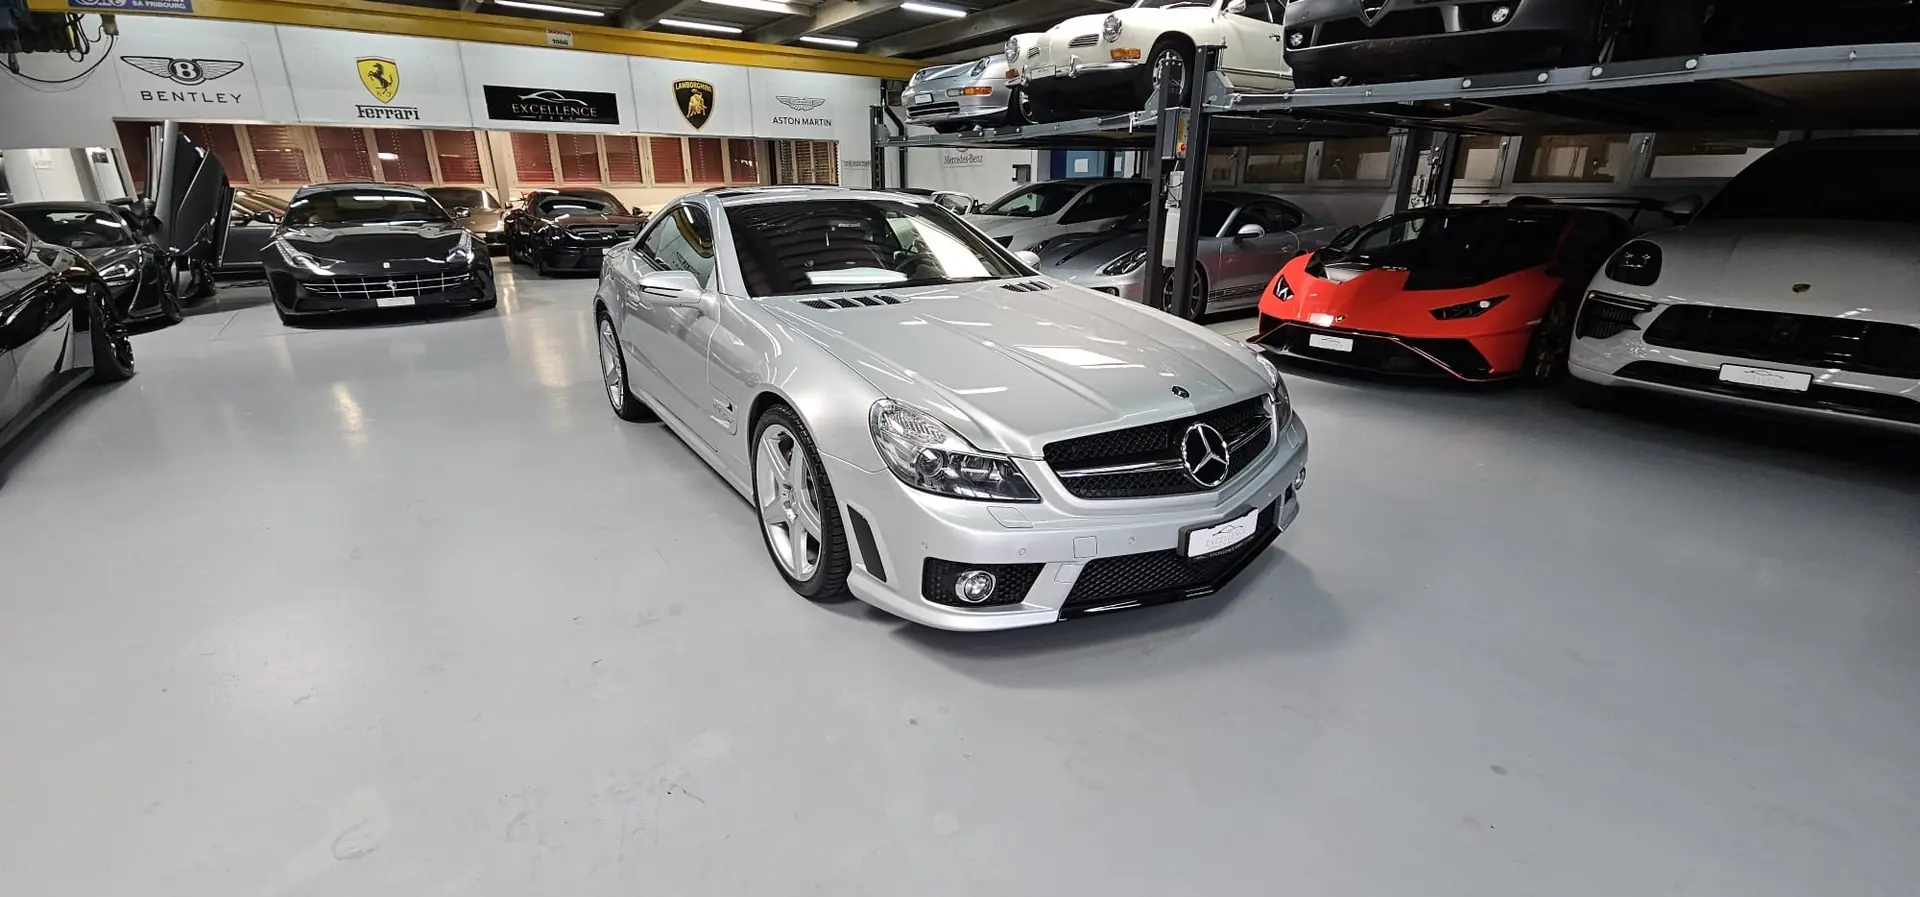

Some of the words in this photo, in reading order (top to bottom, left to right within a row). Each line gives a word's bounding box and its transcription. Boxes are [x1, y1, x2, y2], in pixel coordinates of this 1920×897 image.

[140, 91, 243, 104] BENTLEY
[355, 105, 420, 120] Ferrari
[511, 103, 597, 117] EXCELLENCE
[772, 117, 800, 125] ASTON
[801, 118, 832, 127] MARTIN
[944, 154, 984, 165] Mercedes-Benz
